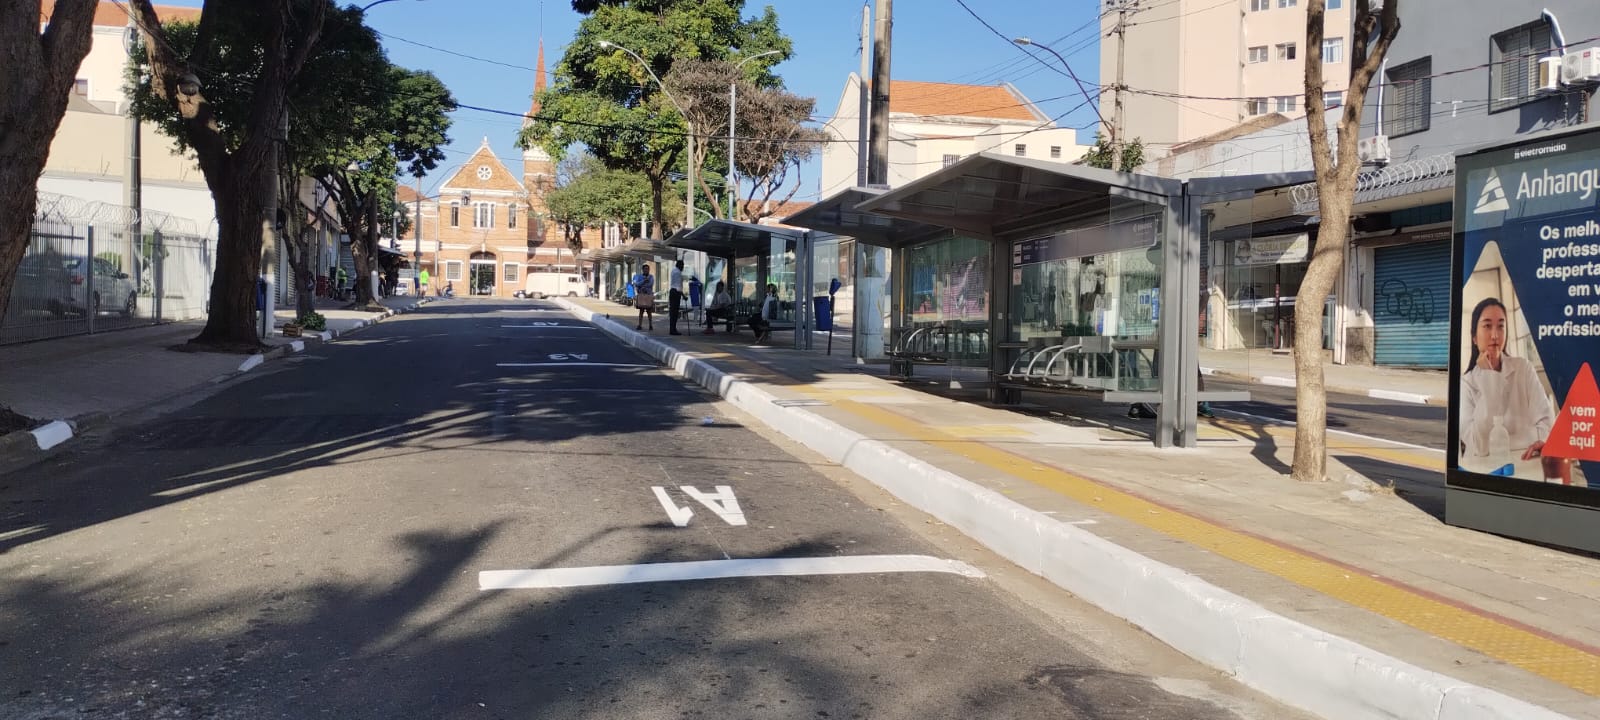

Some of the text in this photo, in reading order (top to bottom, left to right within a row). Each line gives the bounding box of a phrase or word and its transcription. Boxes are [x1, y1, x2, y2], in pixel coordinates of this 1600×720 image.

[1540, 225, 1560, 241] Os
[1542, 242, 1600, 263] profess
[1568, 284, 1590, 297] em
[1564, 304, 1573, 316] o
[547, 352, 589, 361] A3
[1569, 406, 1596, 418] vem
[1571, 421, 1593, 434] por
[1569, 434, 1595, 450] aqui
[651, 485, 747, 527] A1
